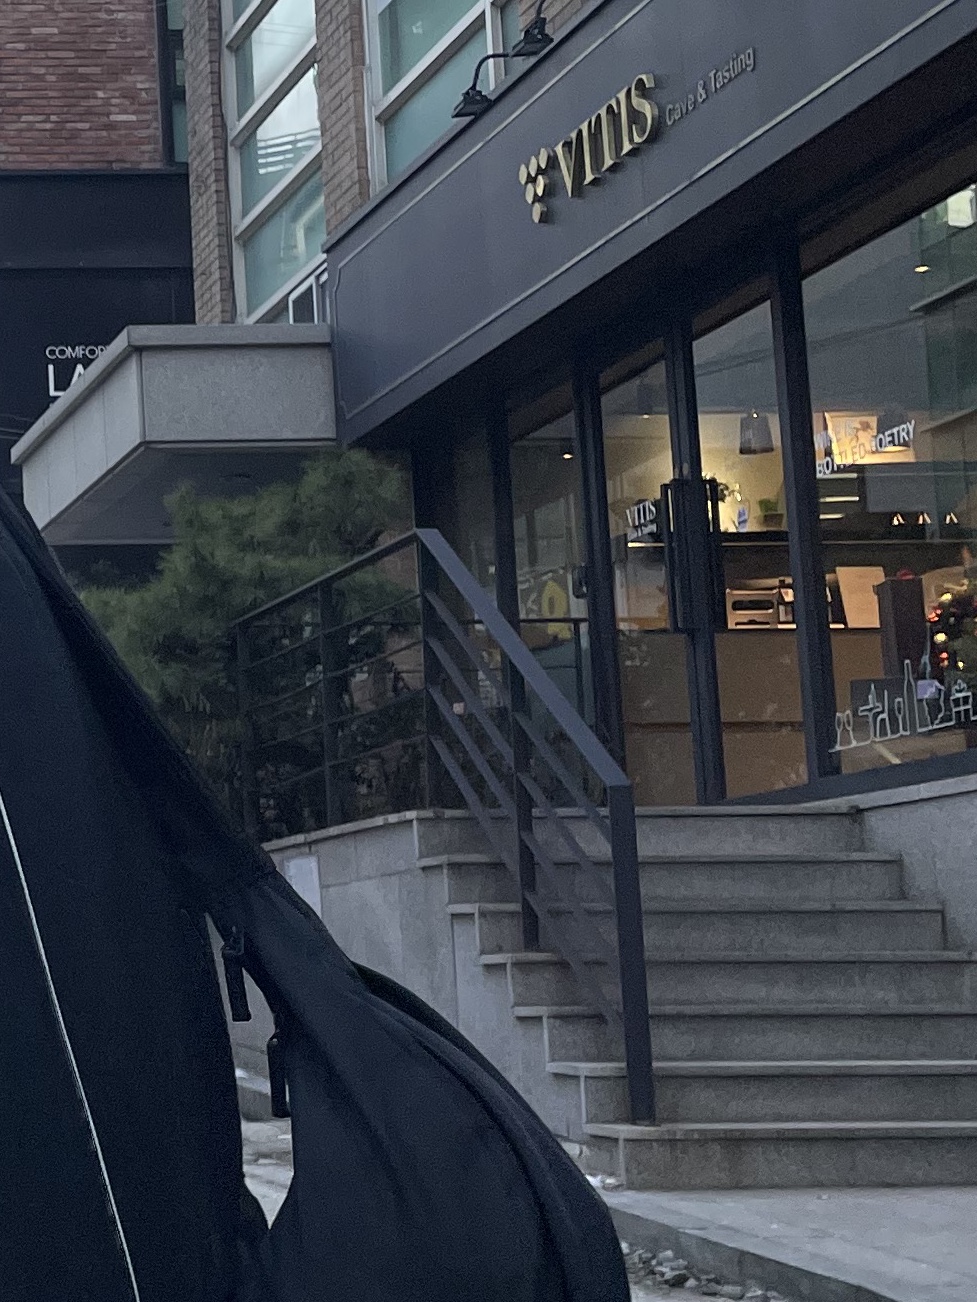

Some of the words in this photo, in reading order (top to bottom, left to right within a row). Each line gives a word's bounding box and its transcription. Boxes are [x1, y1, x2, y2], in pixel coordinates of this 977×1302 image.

[665, 96, 695, 126] Cave
[697, 80, 707, 103] &
[708, 47, 755, 93] Tasting
[554, 72, 658, 198] VITIS
[45, 345, 110, 360] COMFOR
